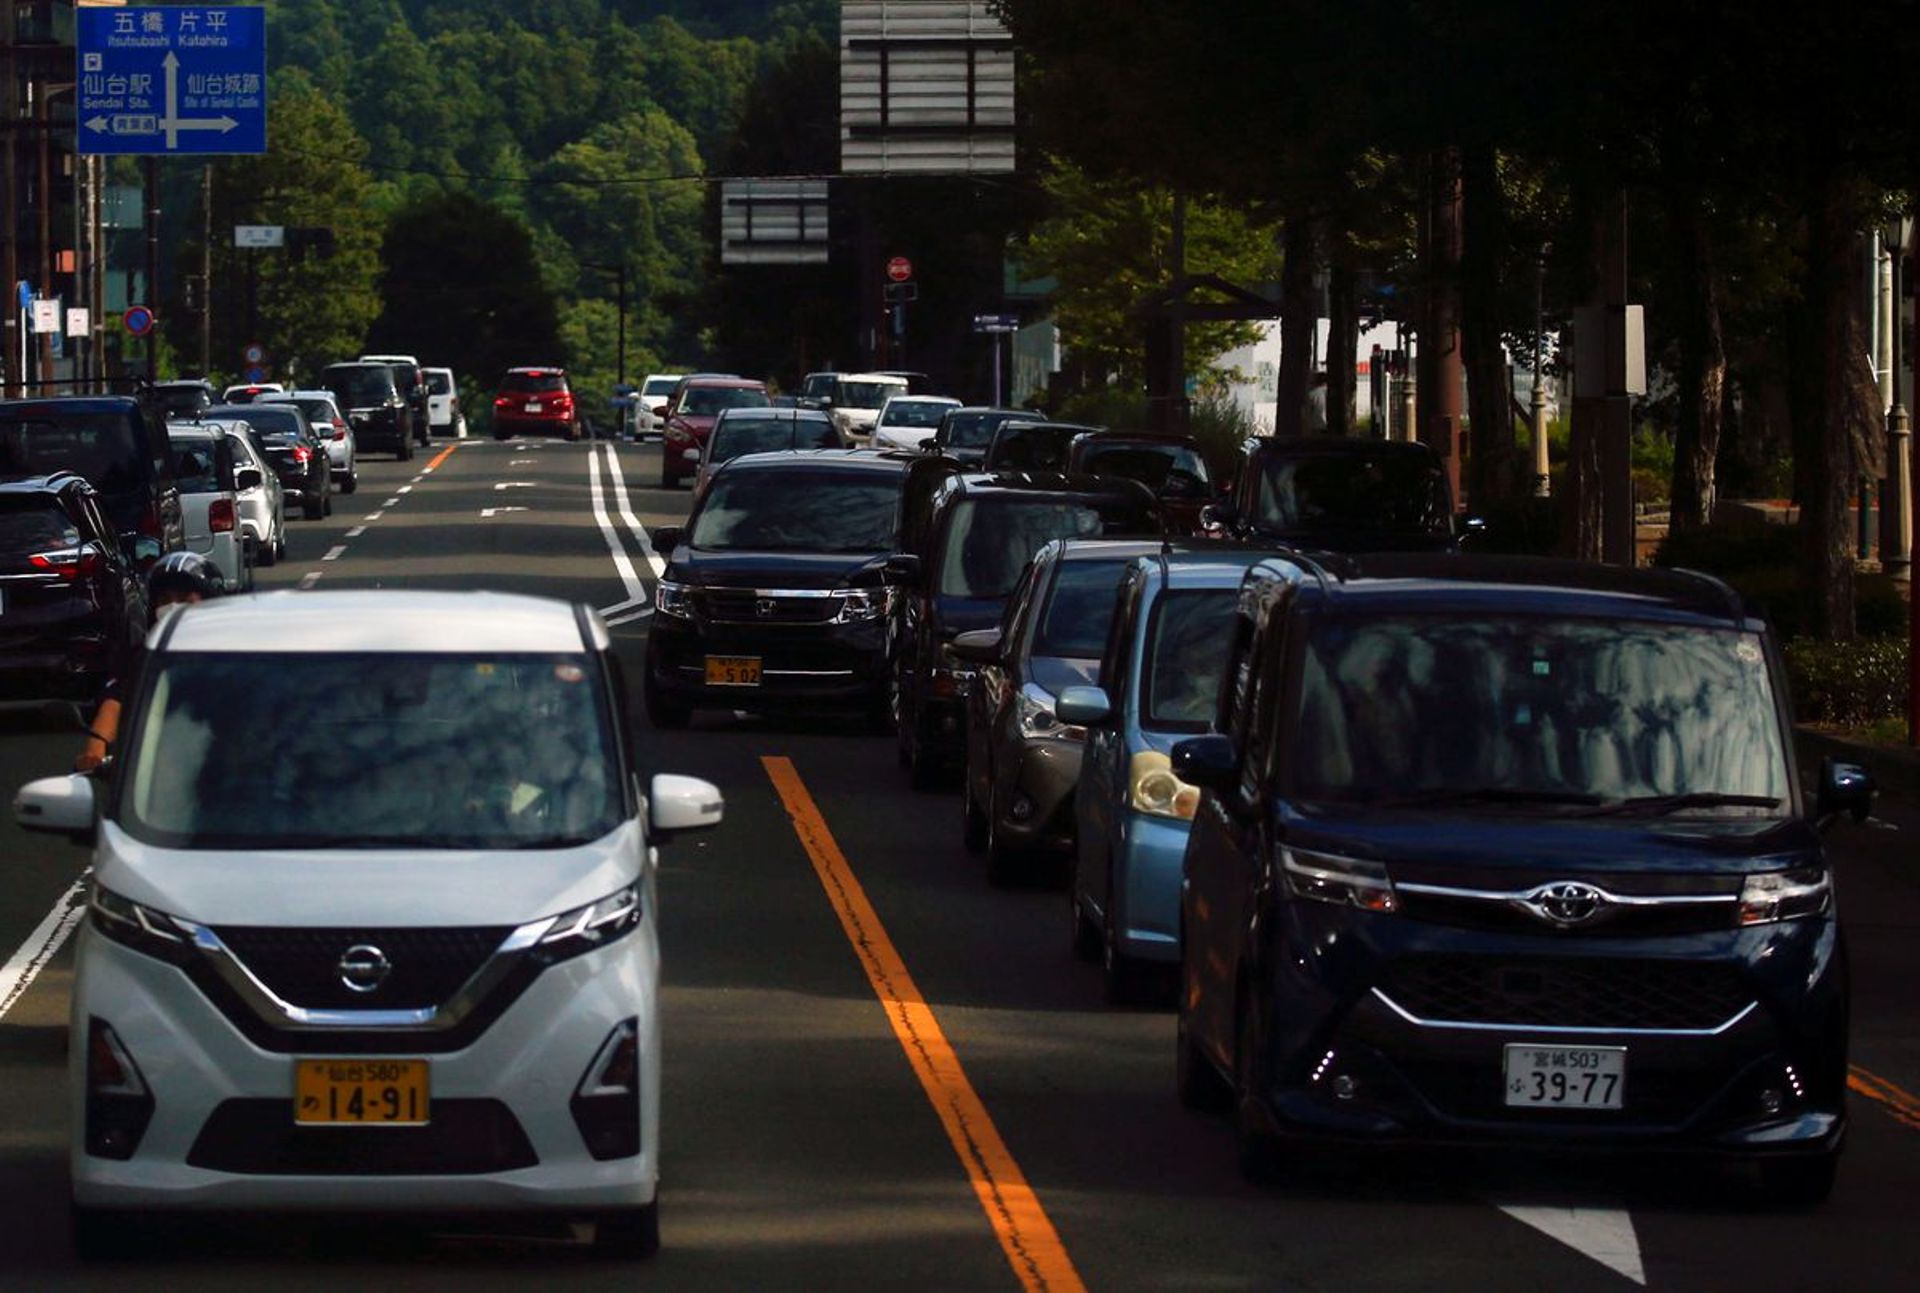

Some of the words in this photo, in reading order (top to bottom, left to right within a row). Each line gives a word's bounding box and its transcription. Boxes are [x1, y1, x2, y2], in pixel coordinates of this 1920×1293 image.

[114, 12, 164, 33] 五橋
[179, 11, 227, 32] 片平
[178, 35, 228, 47] Katahira
[83, 73, 152, 95] 仙台駅
[187, 73, 260, 95] 仙台城跡
[83, 97, 123, 109] Sendai
[129, 97, 150, 109] Sta.
[1530, 1071, 1618, 1103] 39-77
[330, 1086, 416, 1120] 14-91
